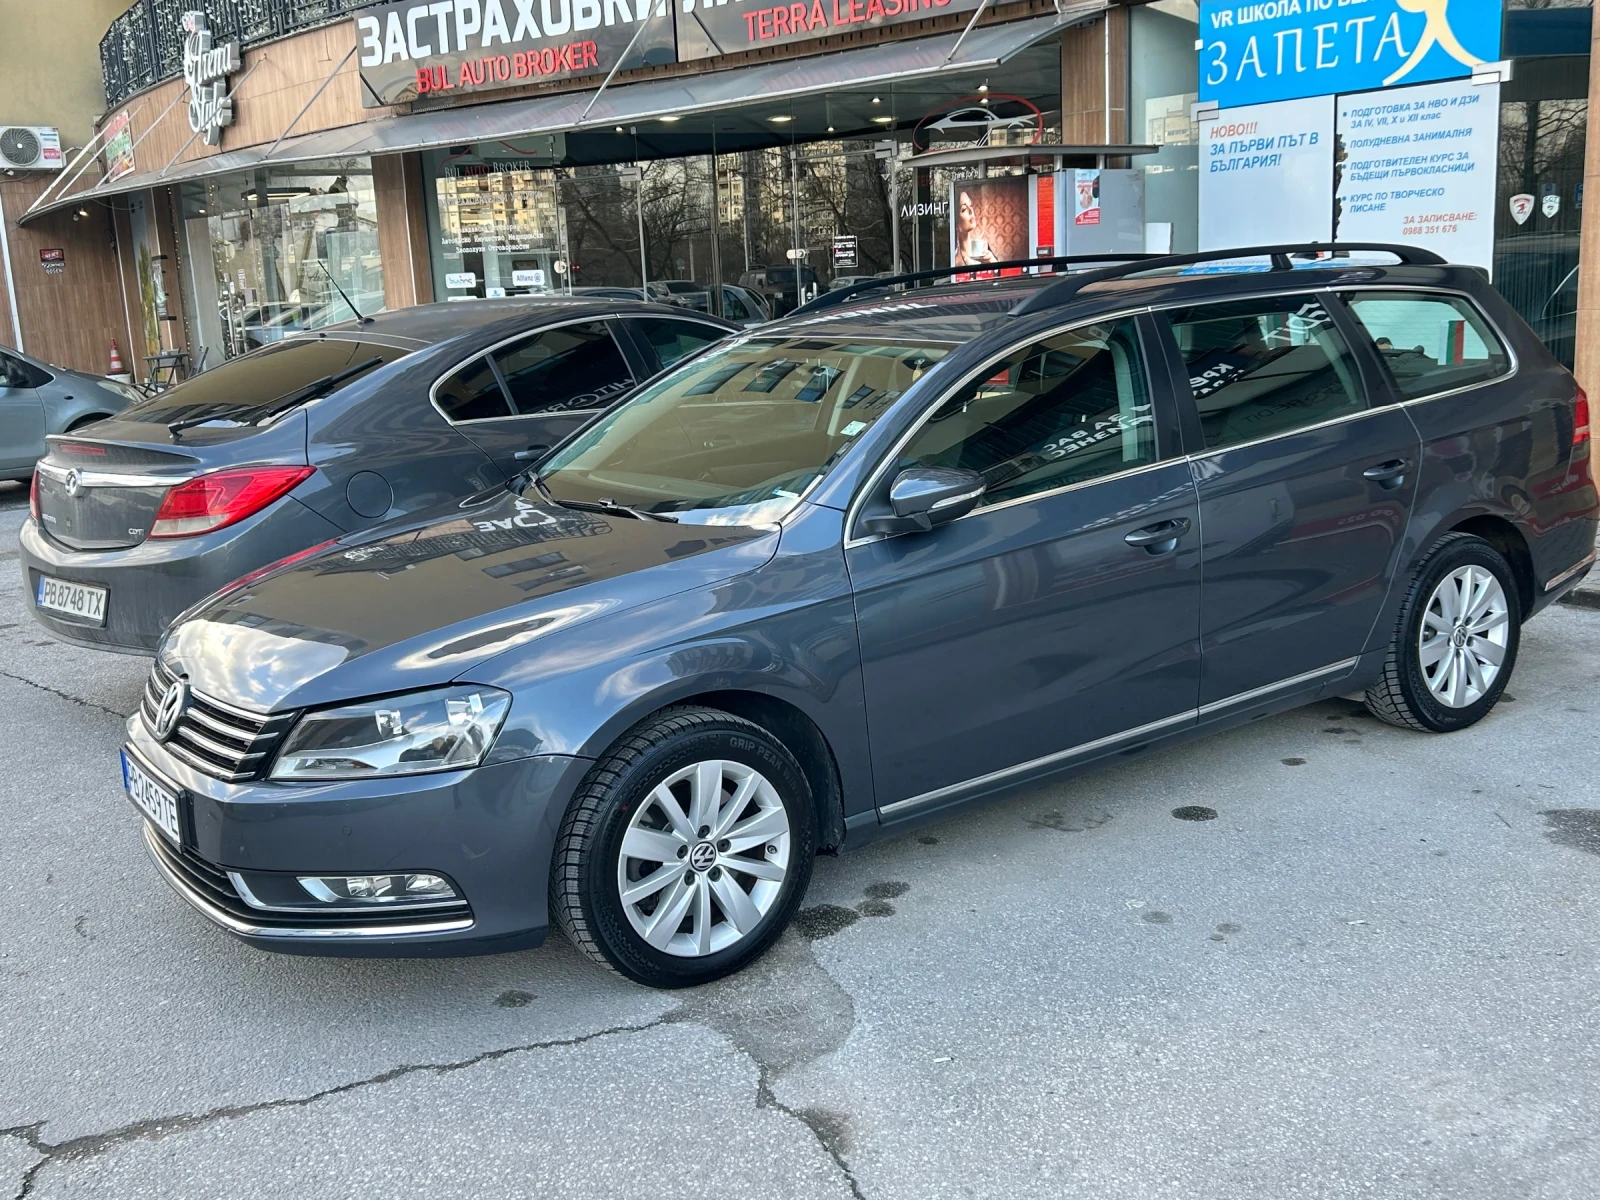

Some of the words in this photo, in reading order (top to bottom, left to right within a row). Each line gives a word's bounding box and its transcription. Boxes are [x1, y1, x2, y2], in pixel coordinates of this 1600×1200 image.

[742, 1, 829, 41] TERRA
[833, 0, 952, 25] LEAS
[1211, 10, 1233, 29] VR
[1237, 0, 1302, 25] ШКОЛА
[1206, 12, 1411, 86] ЗАПЕТА
[416, 68, 455, 94] BUL
[459, 55, 512, 87] AUTO
[514, 40, 599, 79] BROKER
[1350, 103, 1411, 118] ПОДГОТОВКА
[1413, 100, 1426, 110] ЗА
[1427, 98, 1448, 109] НВО
[1449, 97, 1457, 107] И
[1458, 94, 1480, 107] ДЗИ
[1210, 121, 1258, 139] НОВО!!!
[1350, 119, 1364, 129] ЗА
[1407, 114, 1419, 124] XII
[1420, 112, 1442, 122] клас
[1210, 142, 1226, 156] ЗА
[1228, 137, 1275, 154] ПЪРВИ
[1277, 134, 1306, 149] ПЪТ
[1308, 132, 1319, 145] В
[1350, 135, 1410, 149] ПОЛУДНЕВНА
[1412, 128, 1472, 145] ЗАНИМАЛНЯ
[444, 167, 461, 178] BUL
[464, 165, 490, 176] AUTO
[493, 160, 532, 174] BROKER
[1209, 153, 1282, 173] БЪЛГАРИЯ!
[1350, 154, 1428, 171] ПОДГОТВИТЕЛЕН
[1430, 152, 1455, 163] КУРС
[1456, 151, 1469, 161] ЗА
[1350, 170, 1389, 183] БЪДЕЩИ
[1391, 163, 1475, 179] ПЪРВОКЛАСНИЦИ
[1350, 193, 1374, 204] КУРС
[1375, 192, 1388, 201] ПО
[1390, 187, 1445, 200] ТВОРЧЕСКО
[901, 201, 949, 217] ЛИЗИНГ
[1350, 203, 1386, 214] ПИСАНЕ
[1403, 215, 1416, 225] ЗА
[1403, 226, 1423, 236] 0988
[1424, 225, 1440, 235] 351
[1441, 224, 1458, 234] 676
[57, 585, 84, 612] 8748
[87, 590, 103, 616] TX
[730, 737, 755, 752] GRIP
[756, 746, 784, 771] PEAK
[139, 773, 162, 821] 2459
[161, 793, 179, 836] TE
